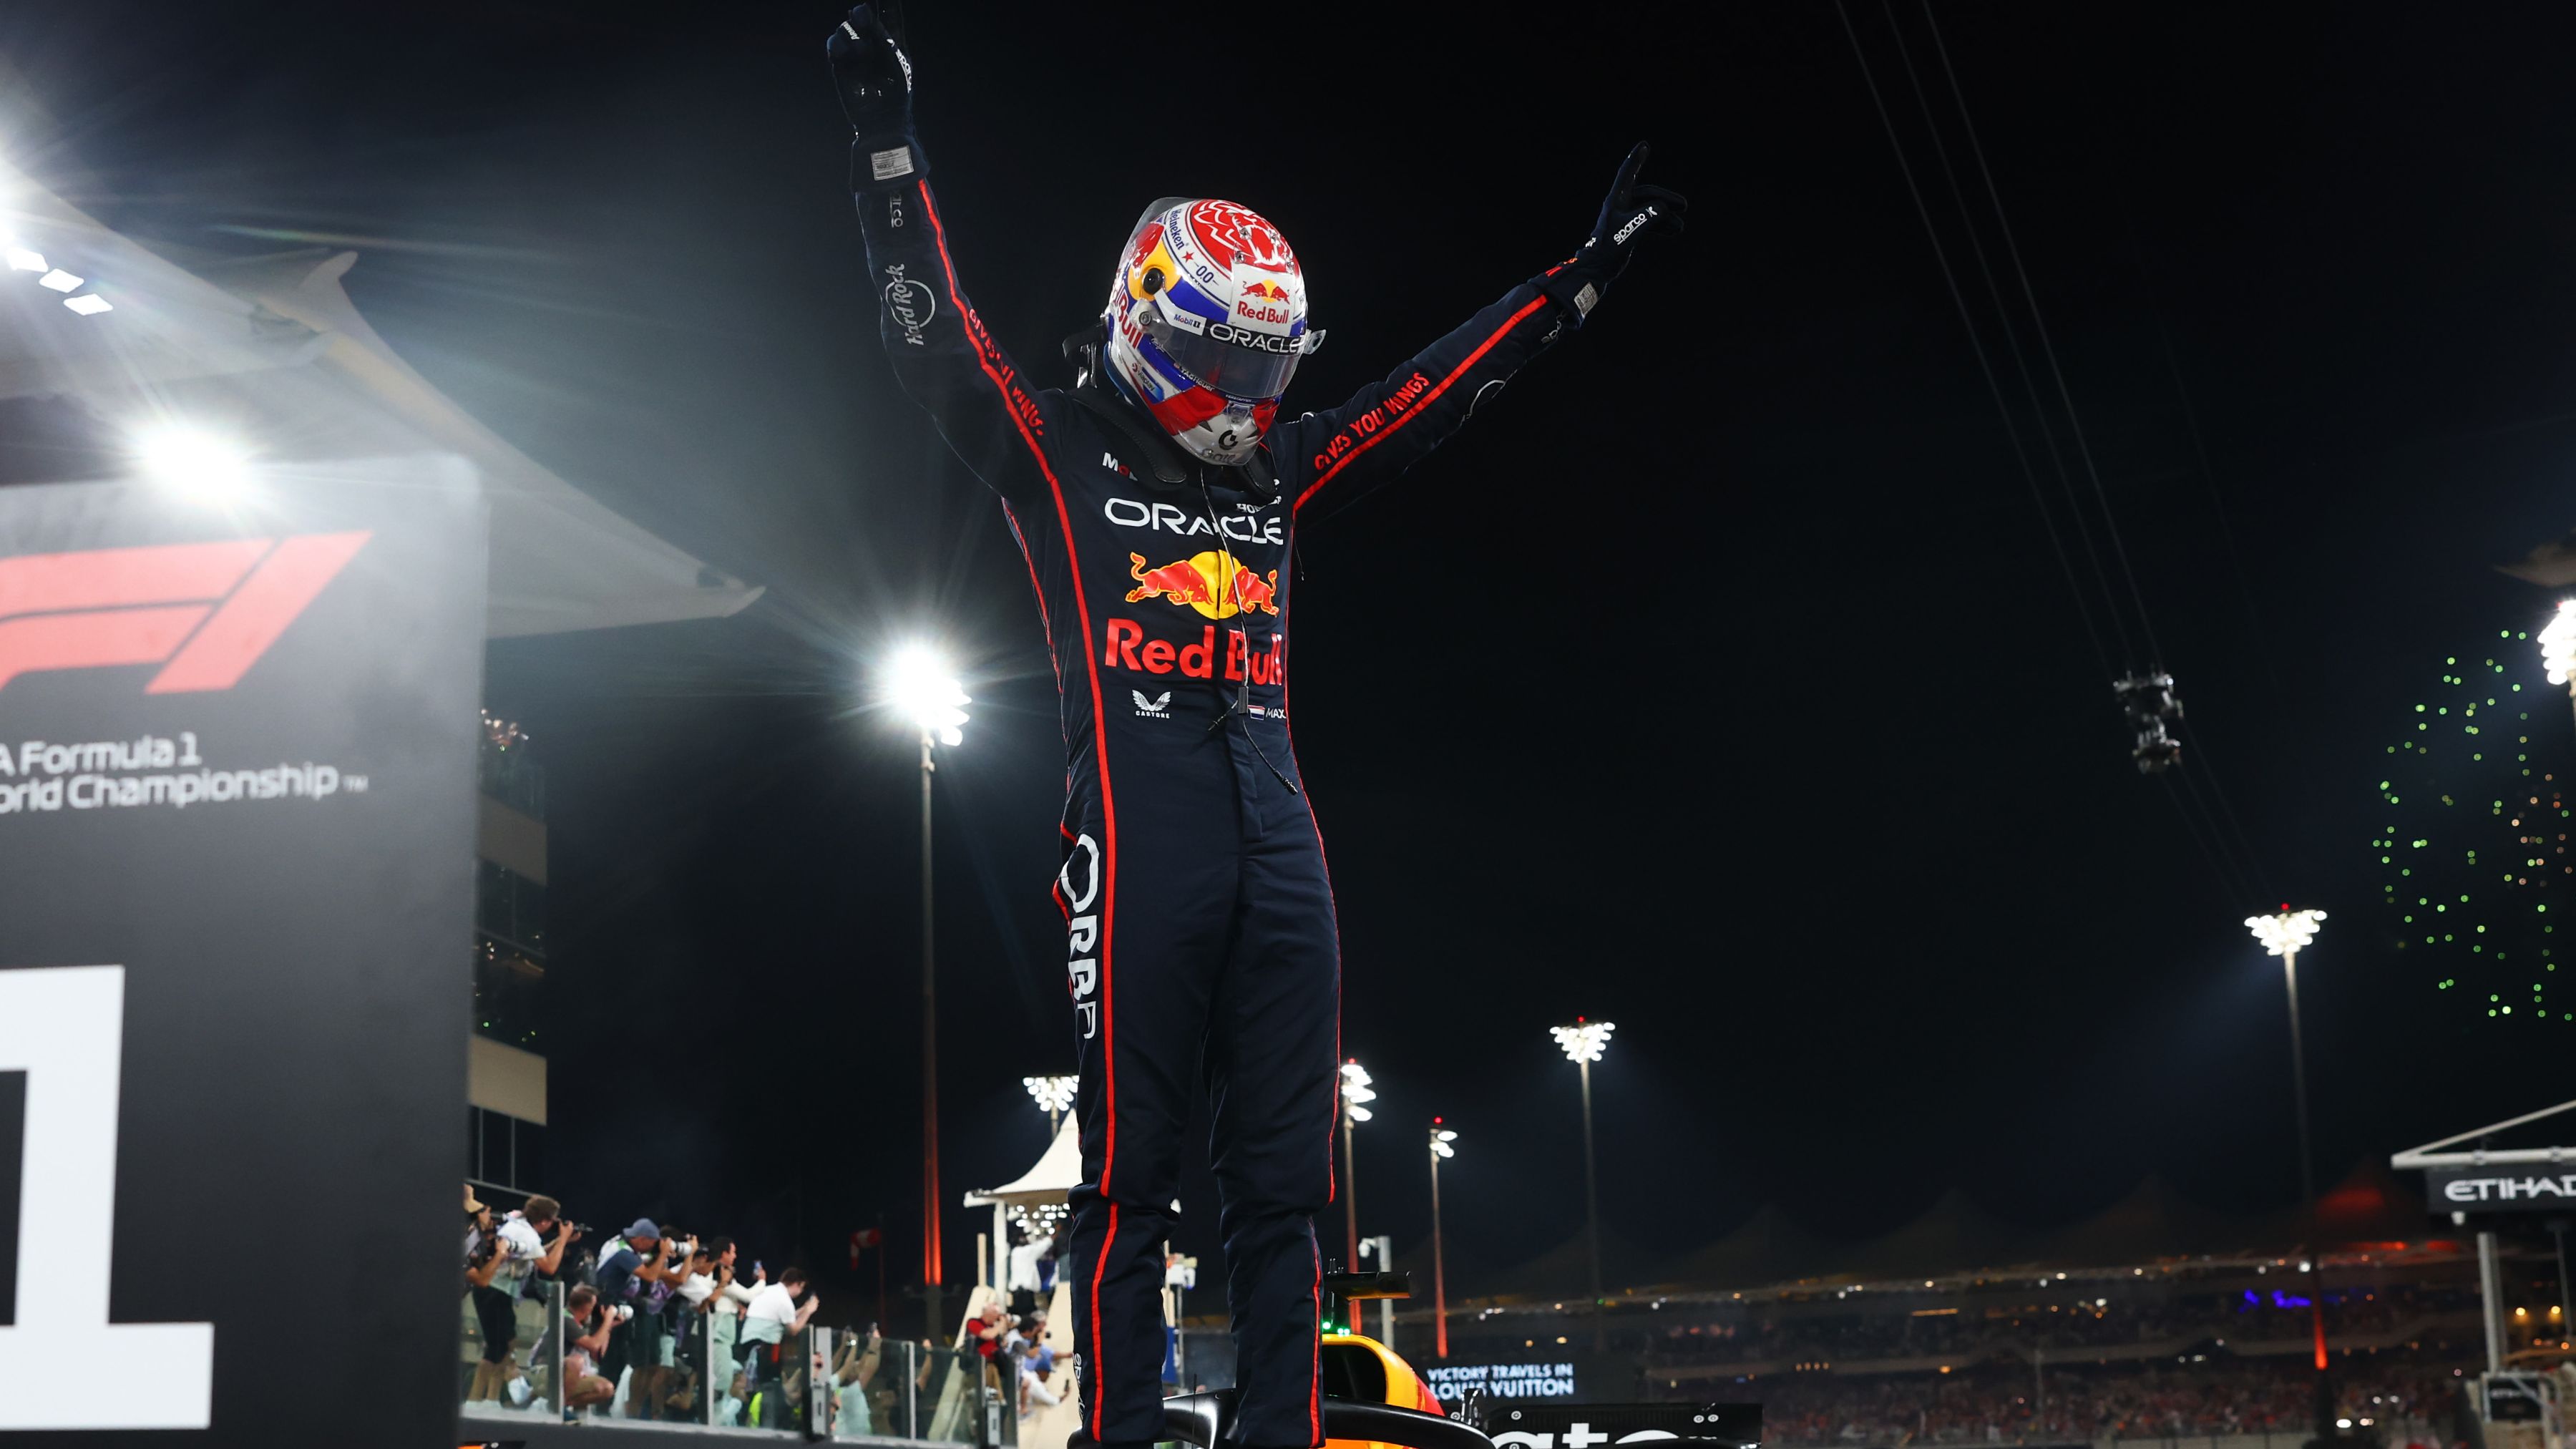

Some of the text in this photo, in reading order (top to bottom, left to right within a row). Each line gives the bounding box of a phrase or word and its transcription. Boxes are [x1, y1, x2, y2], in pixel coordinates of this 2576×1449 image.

[1169, 208, 1185, 250] Heineken
[1614, 213, 1648, 245] sparco
[885, 263, 924, 346] Hard Rock
[1174, 313, 1194, 326] Mobil
[1236, 300, 1290, 324] Red Bull
[1209, 323, 1304, 353] ORACLE
[1349, 407, 1386, 438] YOU
[1382, 372, 1430, 415] WINGS
[1104, 497, 1284, 545] ORACLE
[1105, 618, 1283, 686] Red Bull
[1135, 710, 1171, 719] CASTORE
[1265, 707, 1287, 719] MAX
[20, 736, 175, 775] Formula
[177, 732, 201, 766] 1
[0, 776, 63, 813] orld
[0, 965, 214, 1430] 1
[1427, 1362, 1574, 1381] VICTORY TRAVELS IN
[1489, 1378, 1574, 1397] VUITTON
